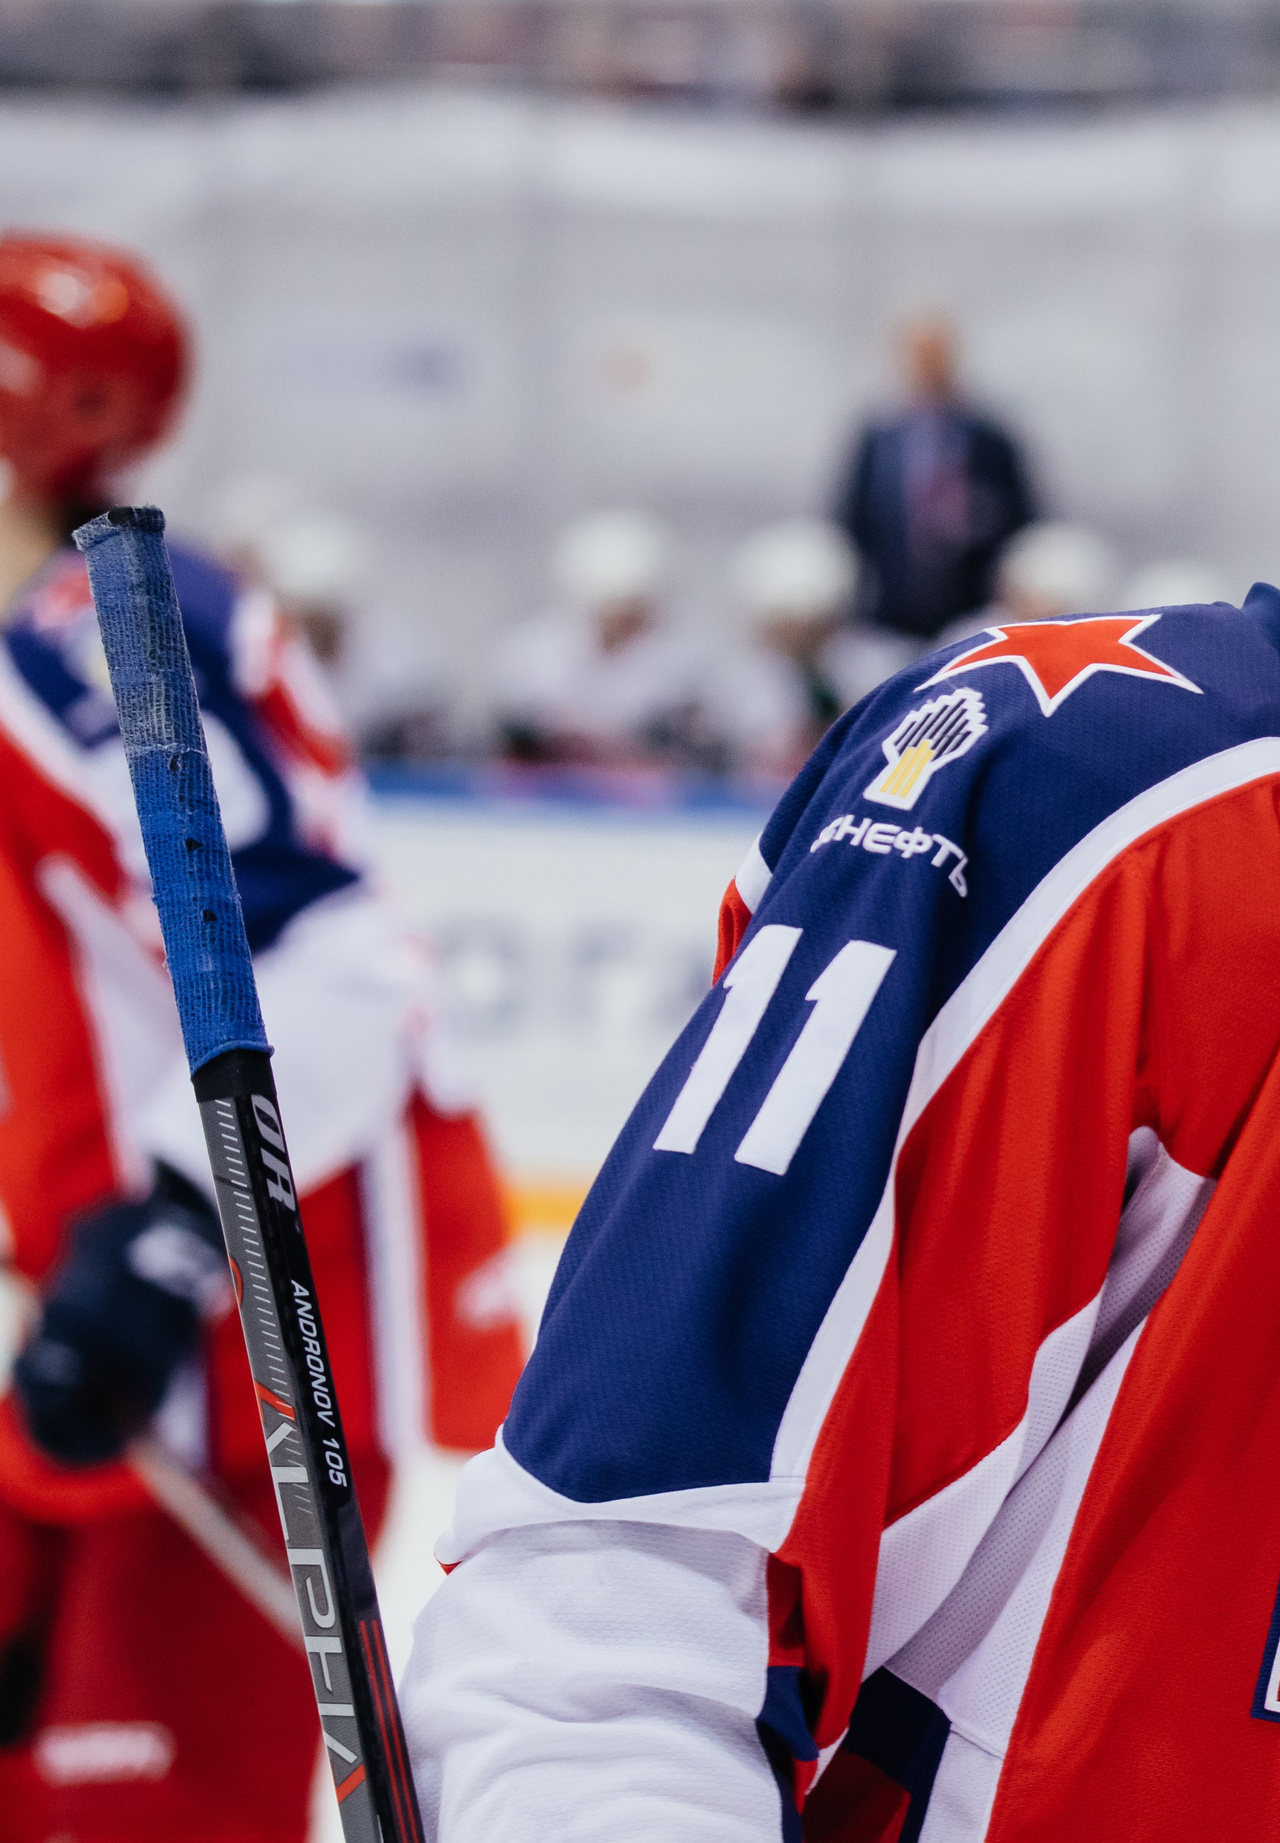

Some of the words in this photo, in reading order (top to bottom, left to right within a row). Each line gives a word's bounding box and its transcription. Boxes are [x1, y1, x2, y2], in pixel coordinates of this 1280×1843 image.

[653, 923, 898, 1176] 11
[290, 1279, 336, 1428] ANDRONOV
[322, 1437, 348, 1488] 105
